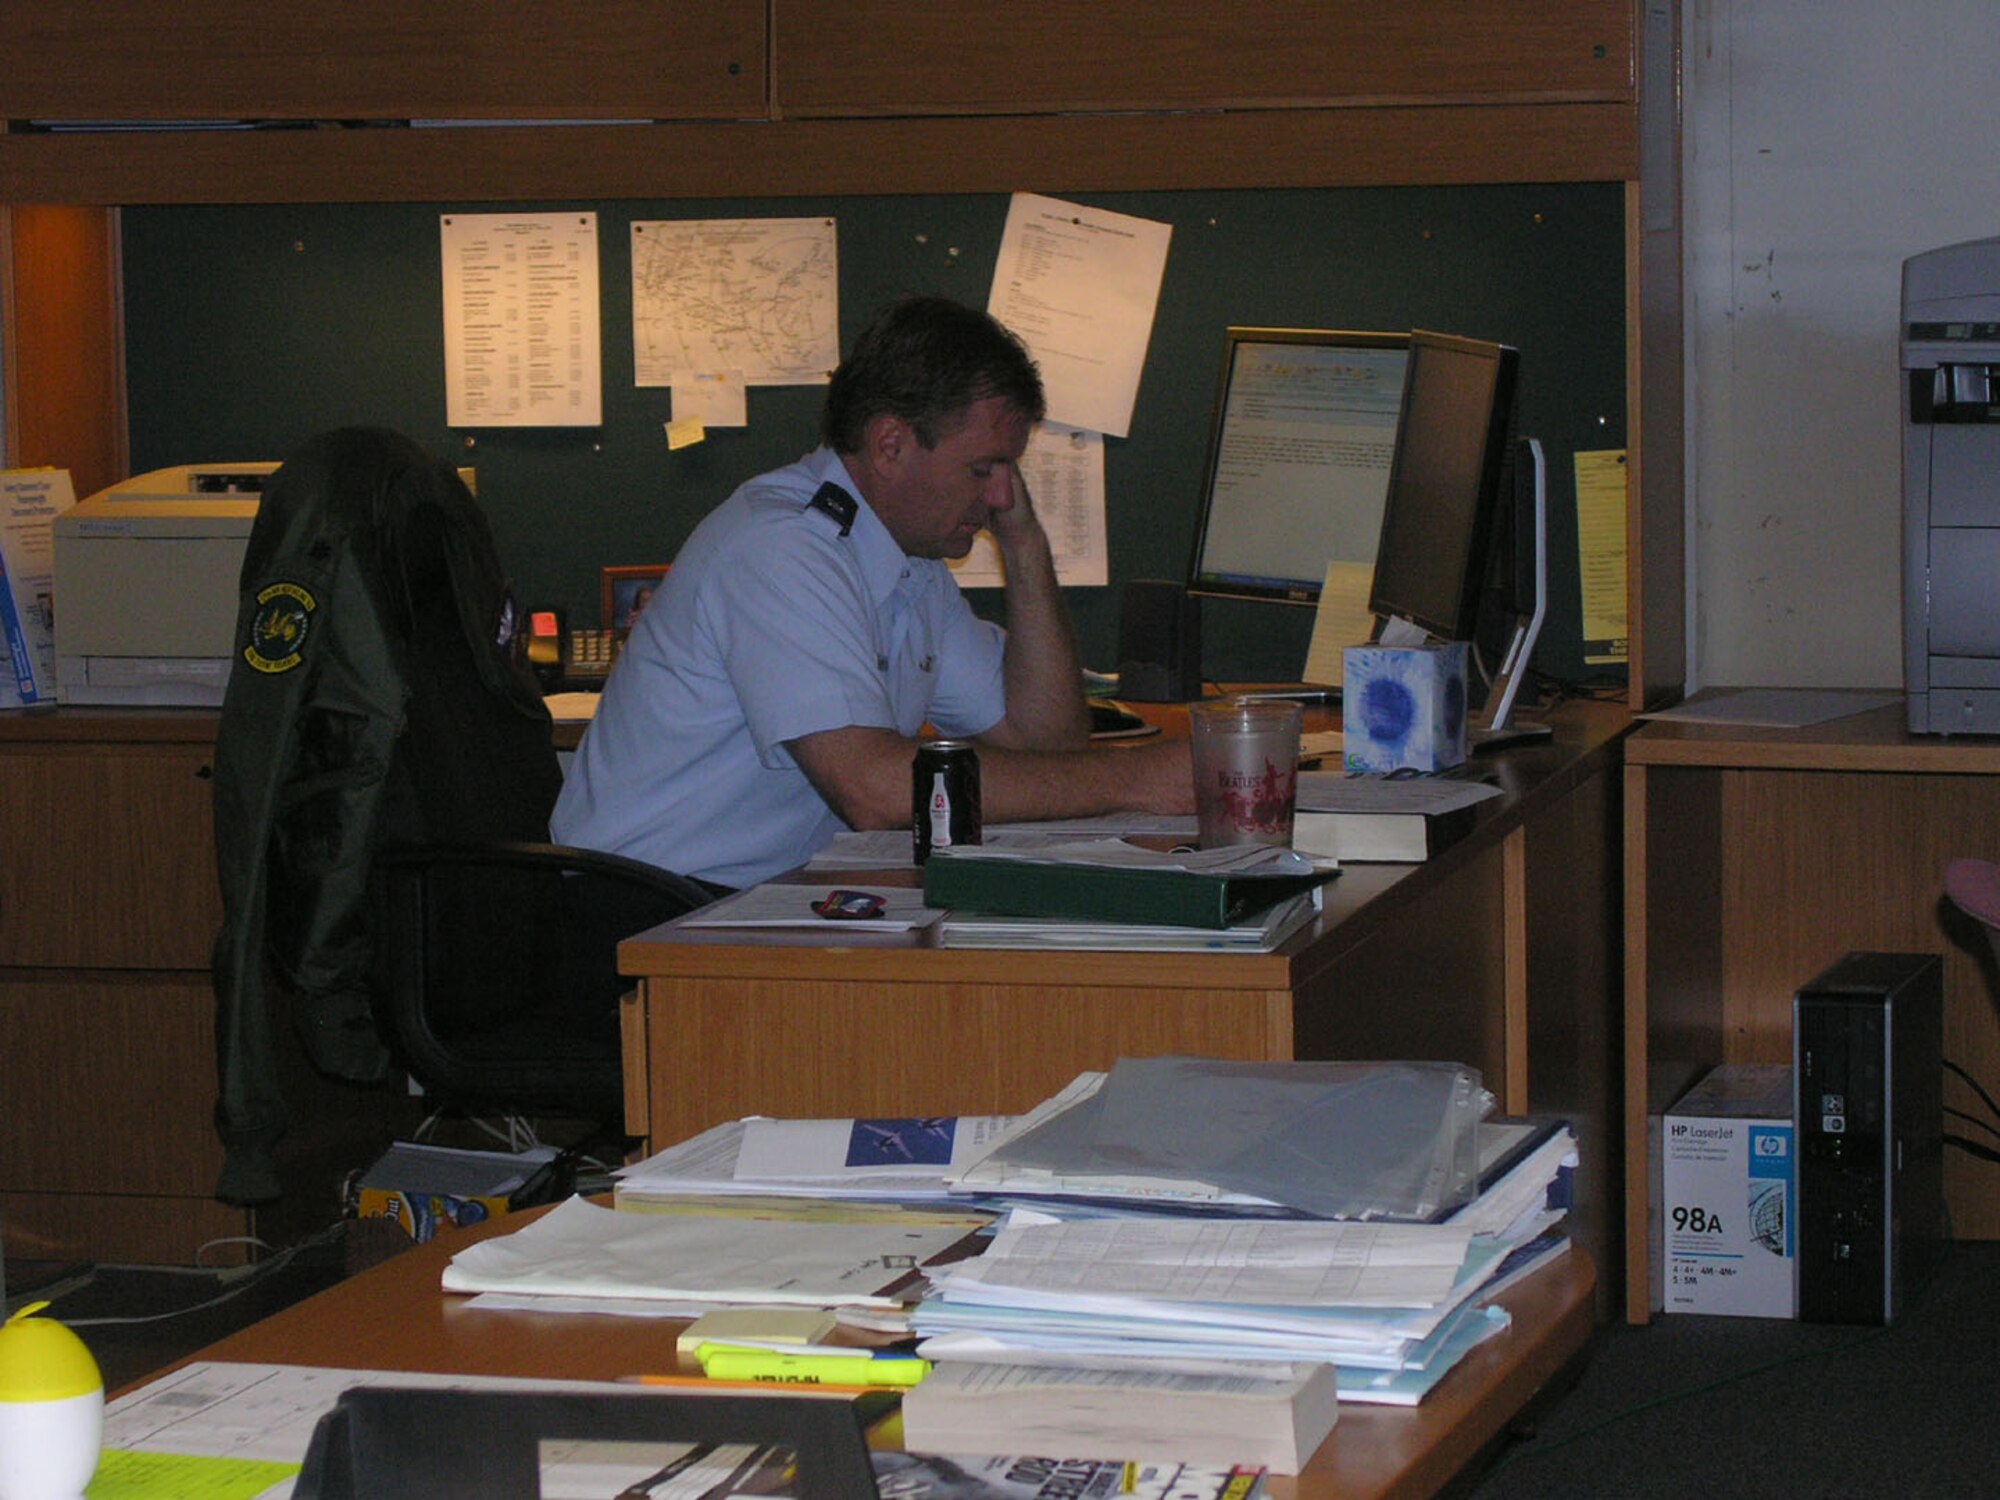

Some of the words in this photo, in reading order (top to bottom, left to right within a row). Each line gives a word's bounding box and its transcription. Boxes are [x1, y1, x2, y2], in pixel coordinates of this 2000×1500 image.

[1671, 1125, 1688, 1136] HP
[1690, 1126, 1733, 1139] LaserJet
[1672, 1206, 1722, 1233] 98A
